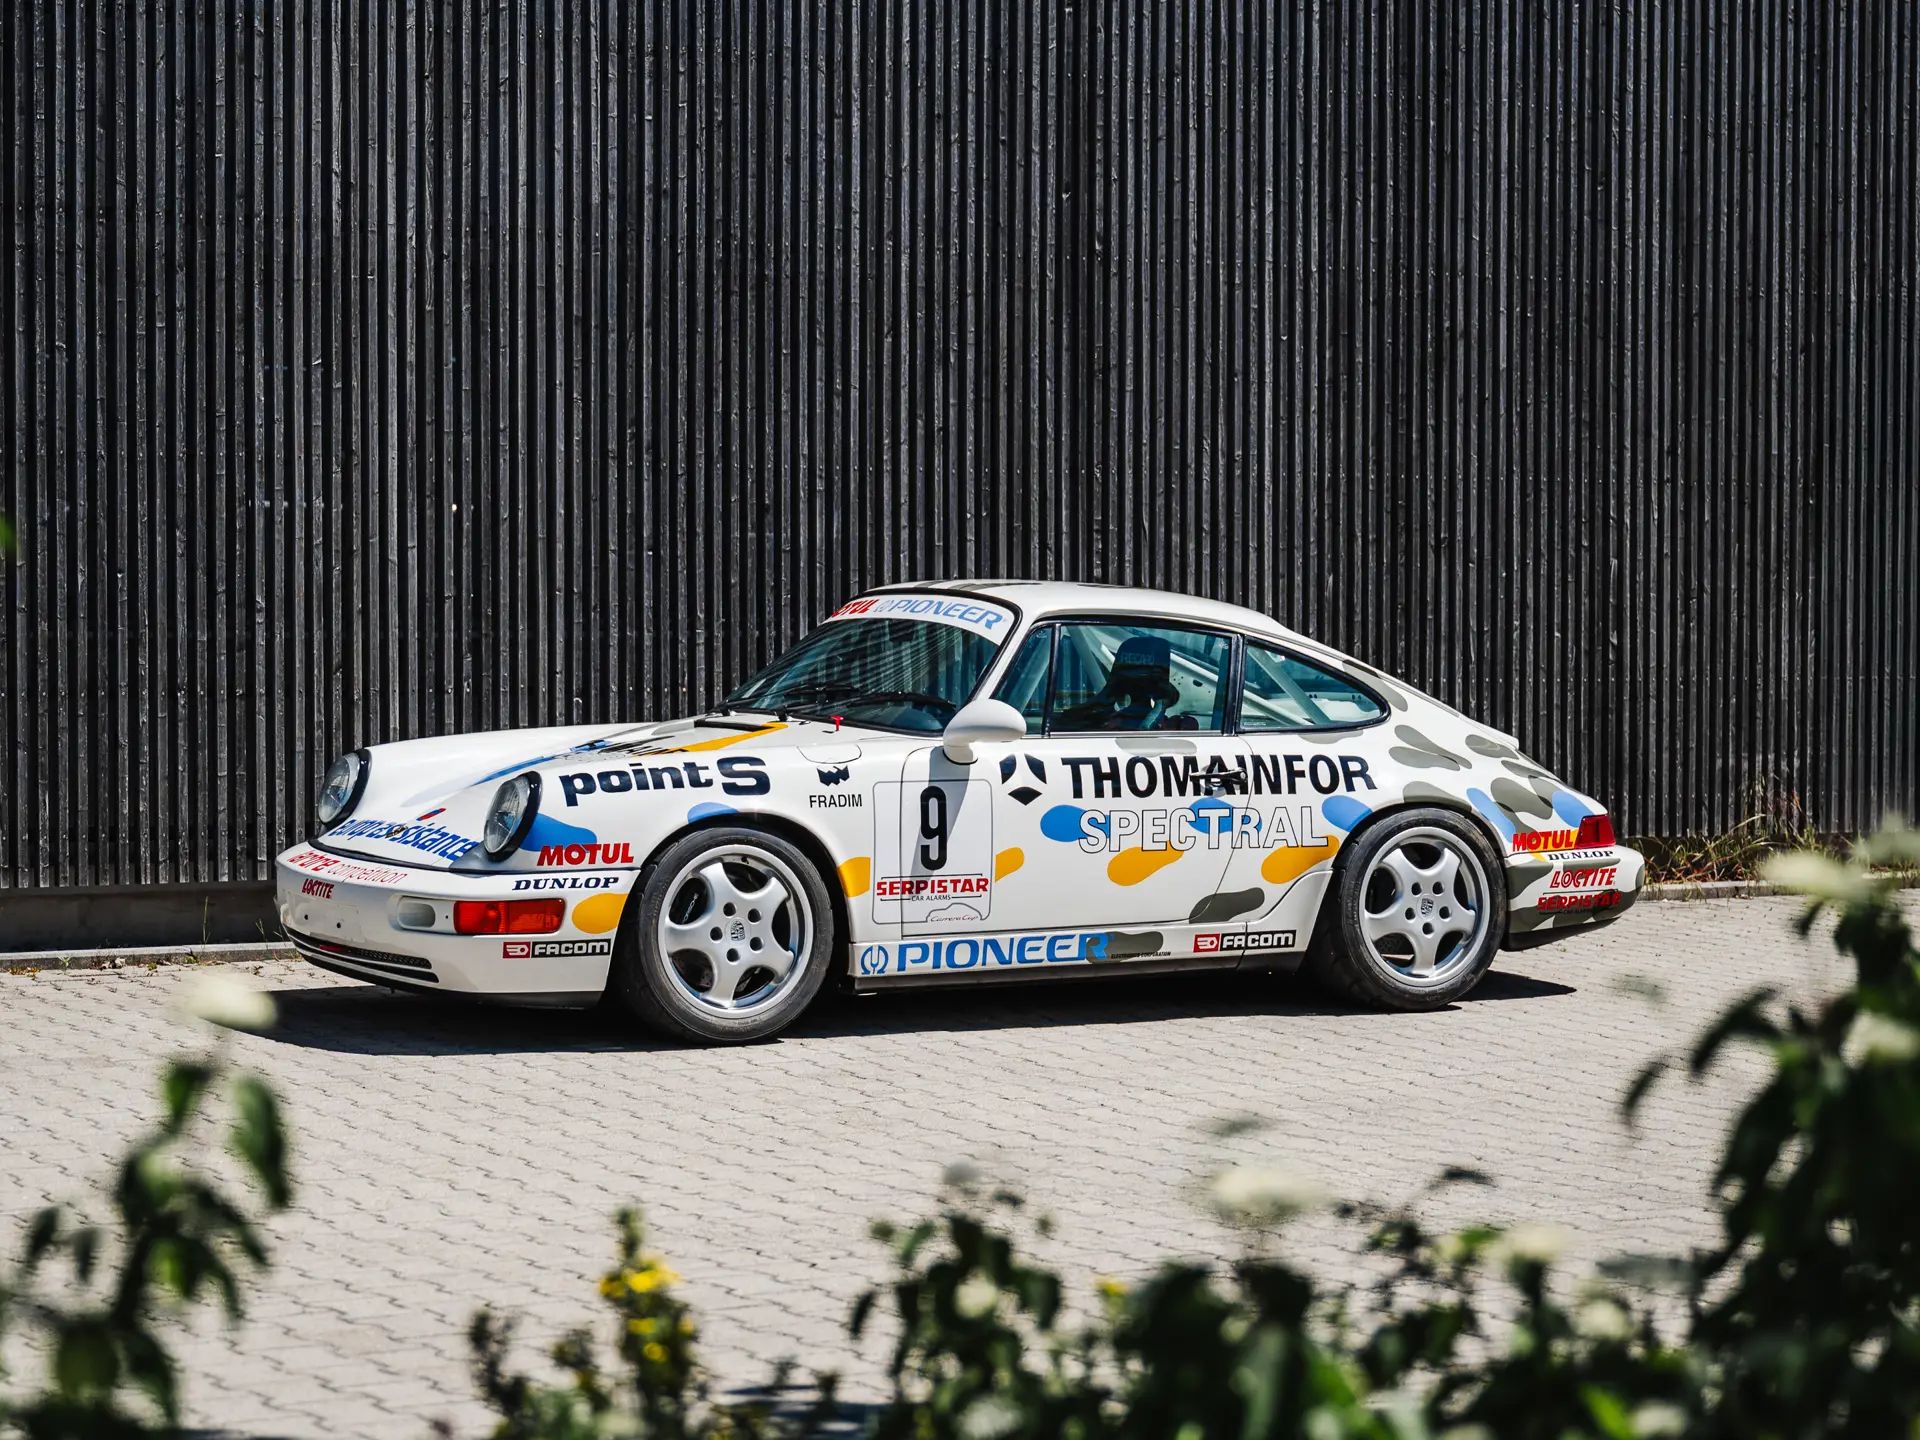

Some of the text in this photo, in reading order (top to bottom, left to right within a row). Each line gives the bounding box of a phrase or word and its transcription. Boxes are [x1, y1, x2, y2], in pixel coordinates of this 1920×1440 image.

[888, 599, 1003, 630] PIONEER
[559, 756, 771, 807] point S
[1060, 754, 1378, 799] THOMAINFOR
[809, 794, 863, 808] FRADIM
[920, 785, 947, 870] 9
[1078, 806, 1328, 854] SPECTRAL
[1512, 829, 1574, 852] MOTUL
[537, 843, 634, 866] MOTUL
[1548, 850, 1613, 861] DUNLOP
[302, 878, 335, 899] LOCTITE
[512, 877, 619, 891] DUNLOP
[876, 878, 990, 896] SERPISTAR
[1550, 867, 1617, 888] LOCTITE
[534, 941, 609, 956] FACOM
[896, 931, 1110, 972] PIONEER
[1222, 933, 1293, 949] FACOM
